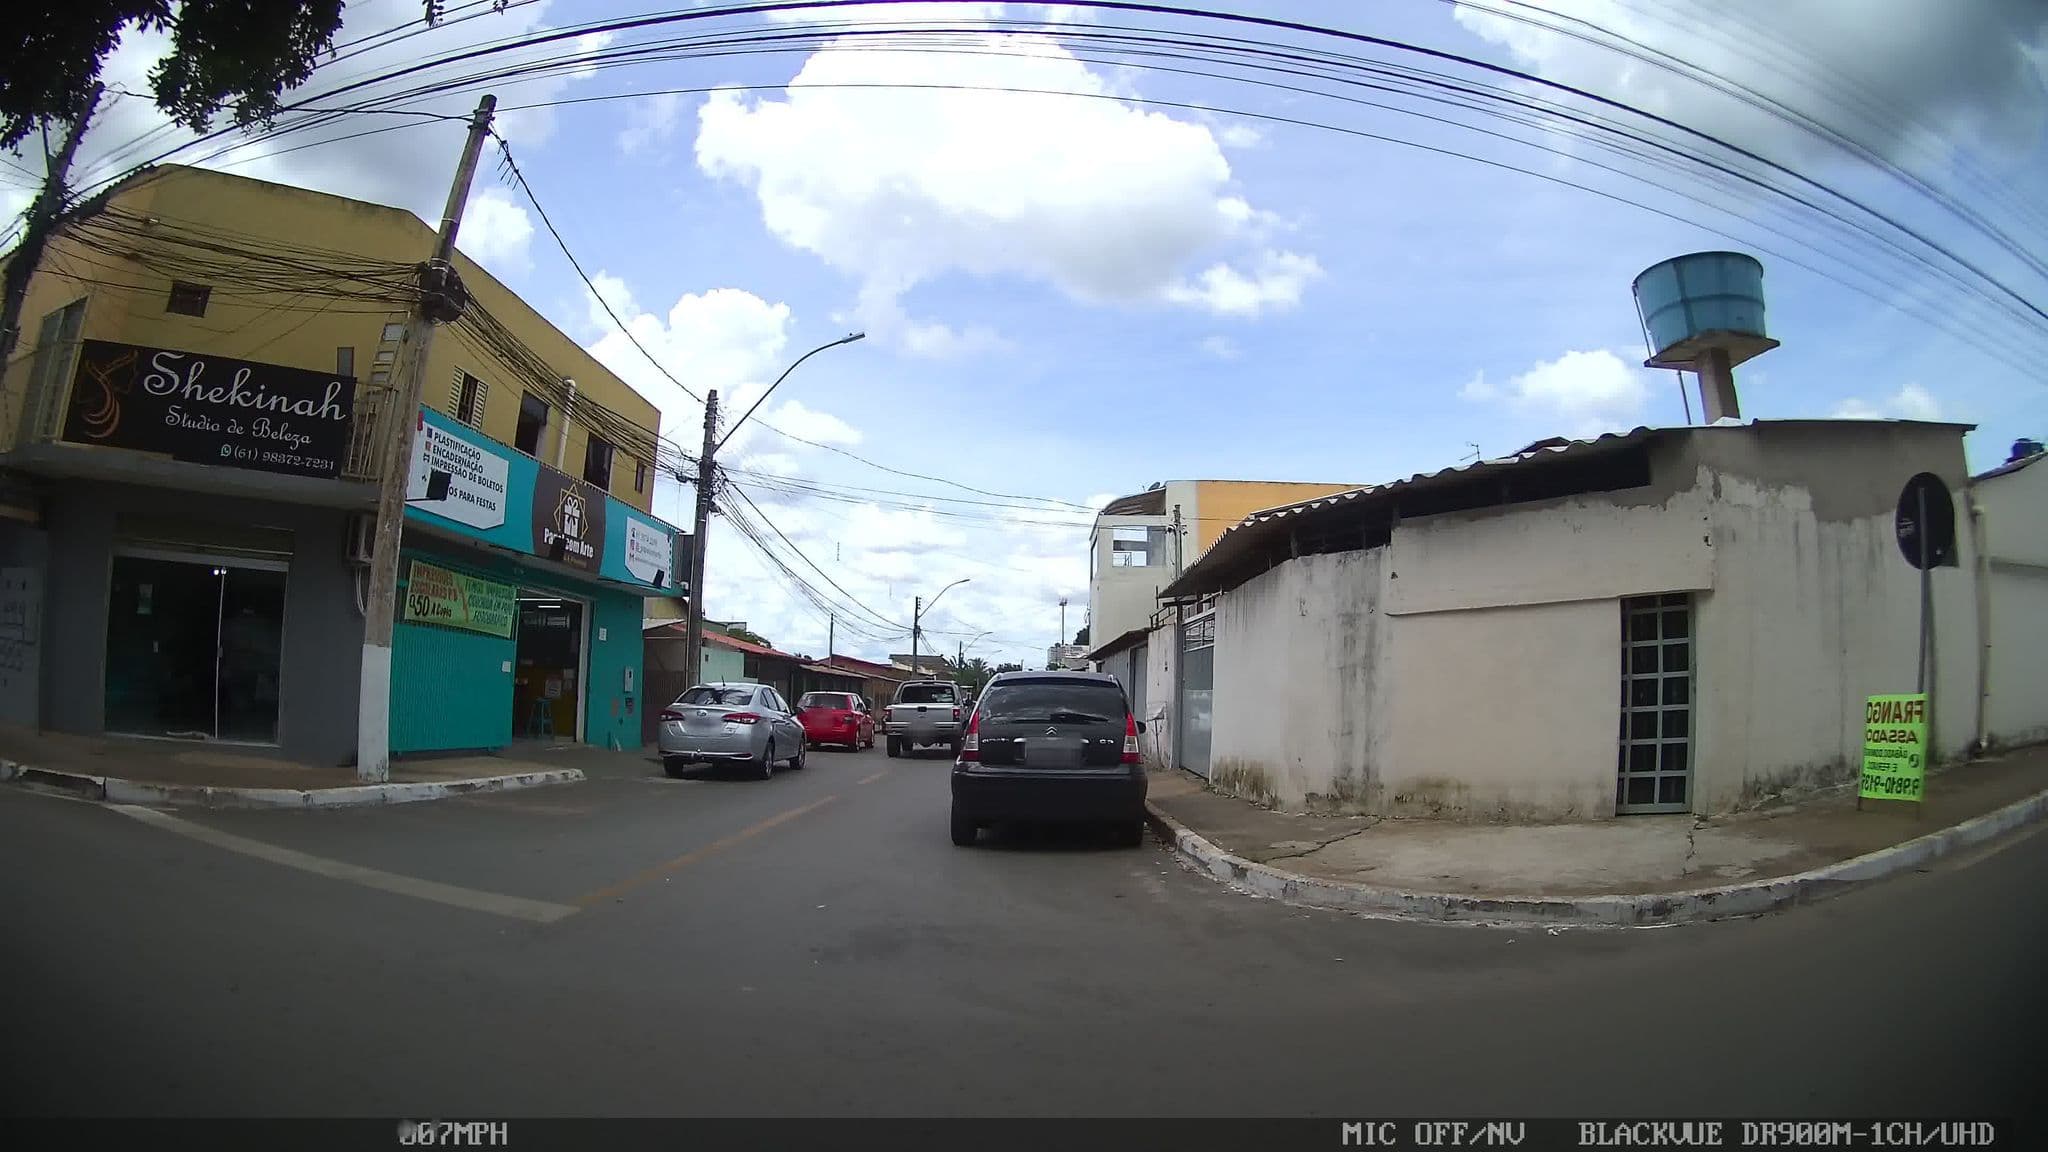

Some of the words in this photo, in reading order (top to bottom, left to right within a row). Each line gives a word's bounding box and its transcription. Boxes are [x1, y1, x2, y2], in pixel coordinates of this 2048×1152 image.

[143, 351, 346, 421] Shekinah
[165, 405, 220, 432] Studio
[227, 418, 245, 436] de
[252, 417, 312, 450] Beleza
[234, 446, 258, 462] (61)
[262, 451, 335, 471] 98372-7231
[432, 445, 484, 474] ENCADERNAÇÃO
[434, 432, 481, 461] PLASTIFICAÇÃO
[468, 472, 477, 483] DE
[478, 475, 503, 494] BOLETOS
[459, 490, 475, 505] PARA
[476, 496, 496, 511] FESTAS
[580, 538, 594, 559] Arte
